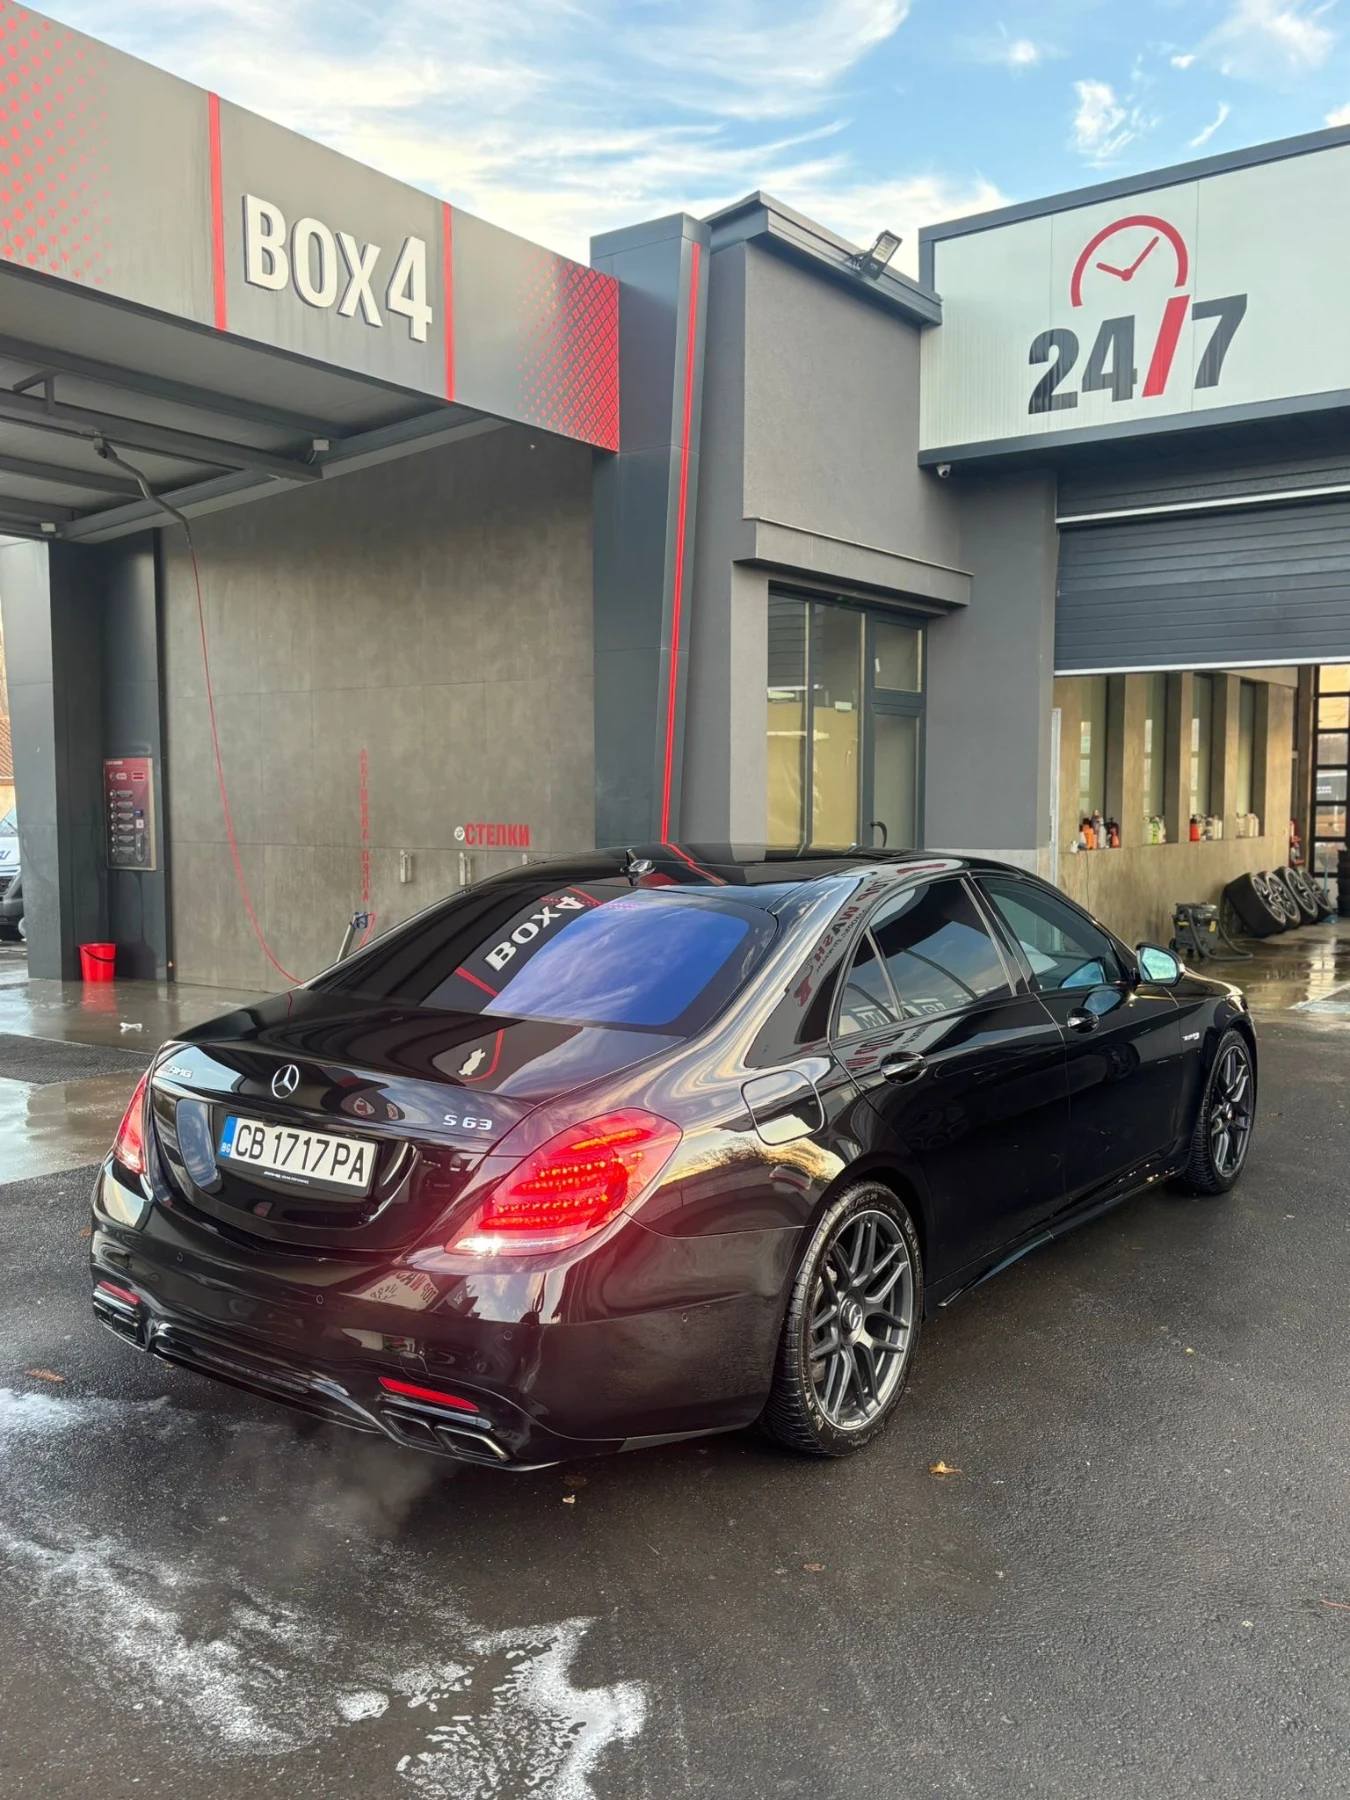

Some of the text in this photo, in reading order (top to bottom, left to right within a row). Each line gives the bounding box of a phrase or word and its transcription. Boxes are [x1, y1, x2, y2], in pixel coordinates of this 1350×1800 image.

[242, 193, 433, 344] BOX 4
[1028, 293, 1248, 415] 24/7
[464, 823, 531, 847] СТЕЛКИ
[442, 1114, 493, 1131] S 63
[220, 1142, 232, 1154] BG
